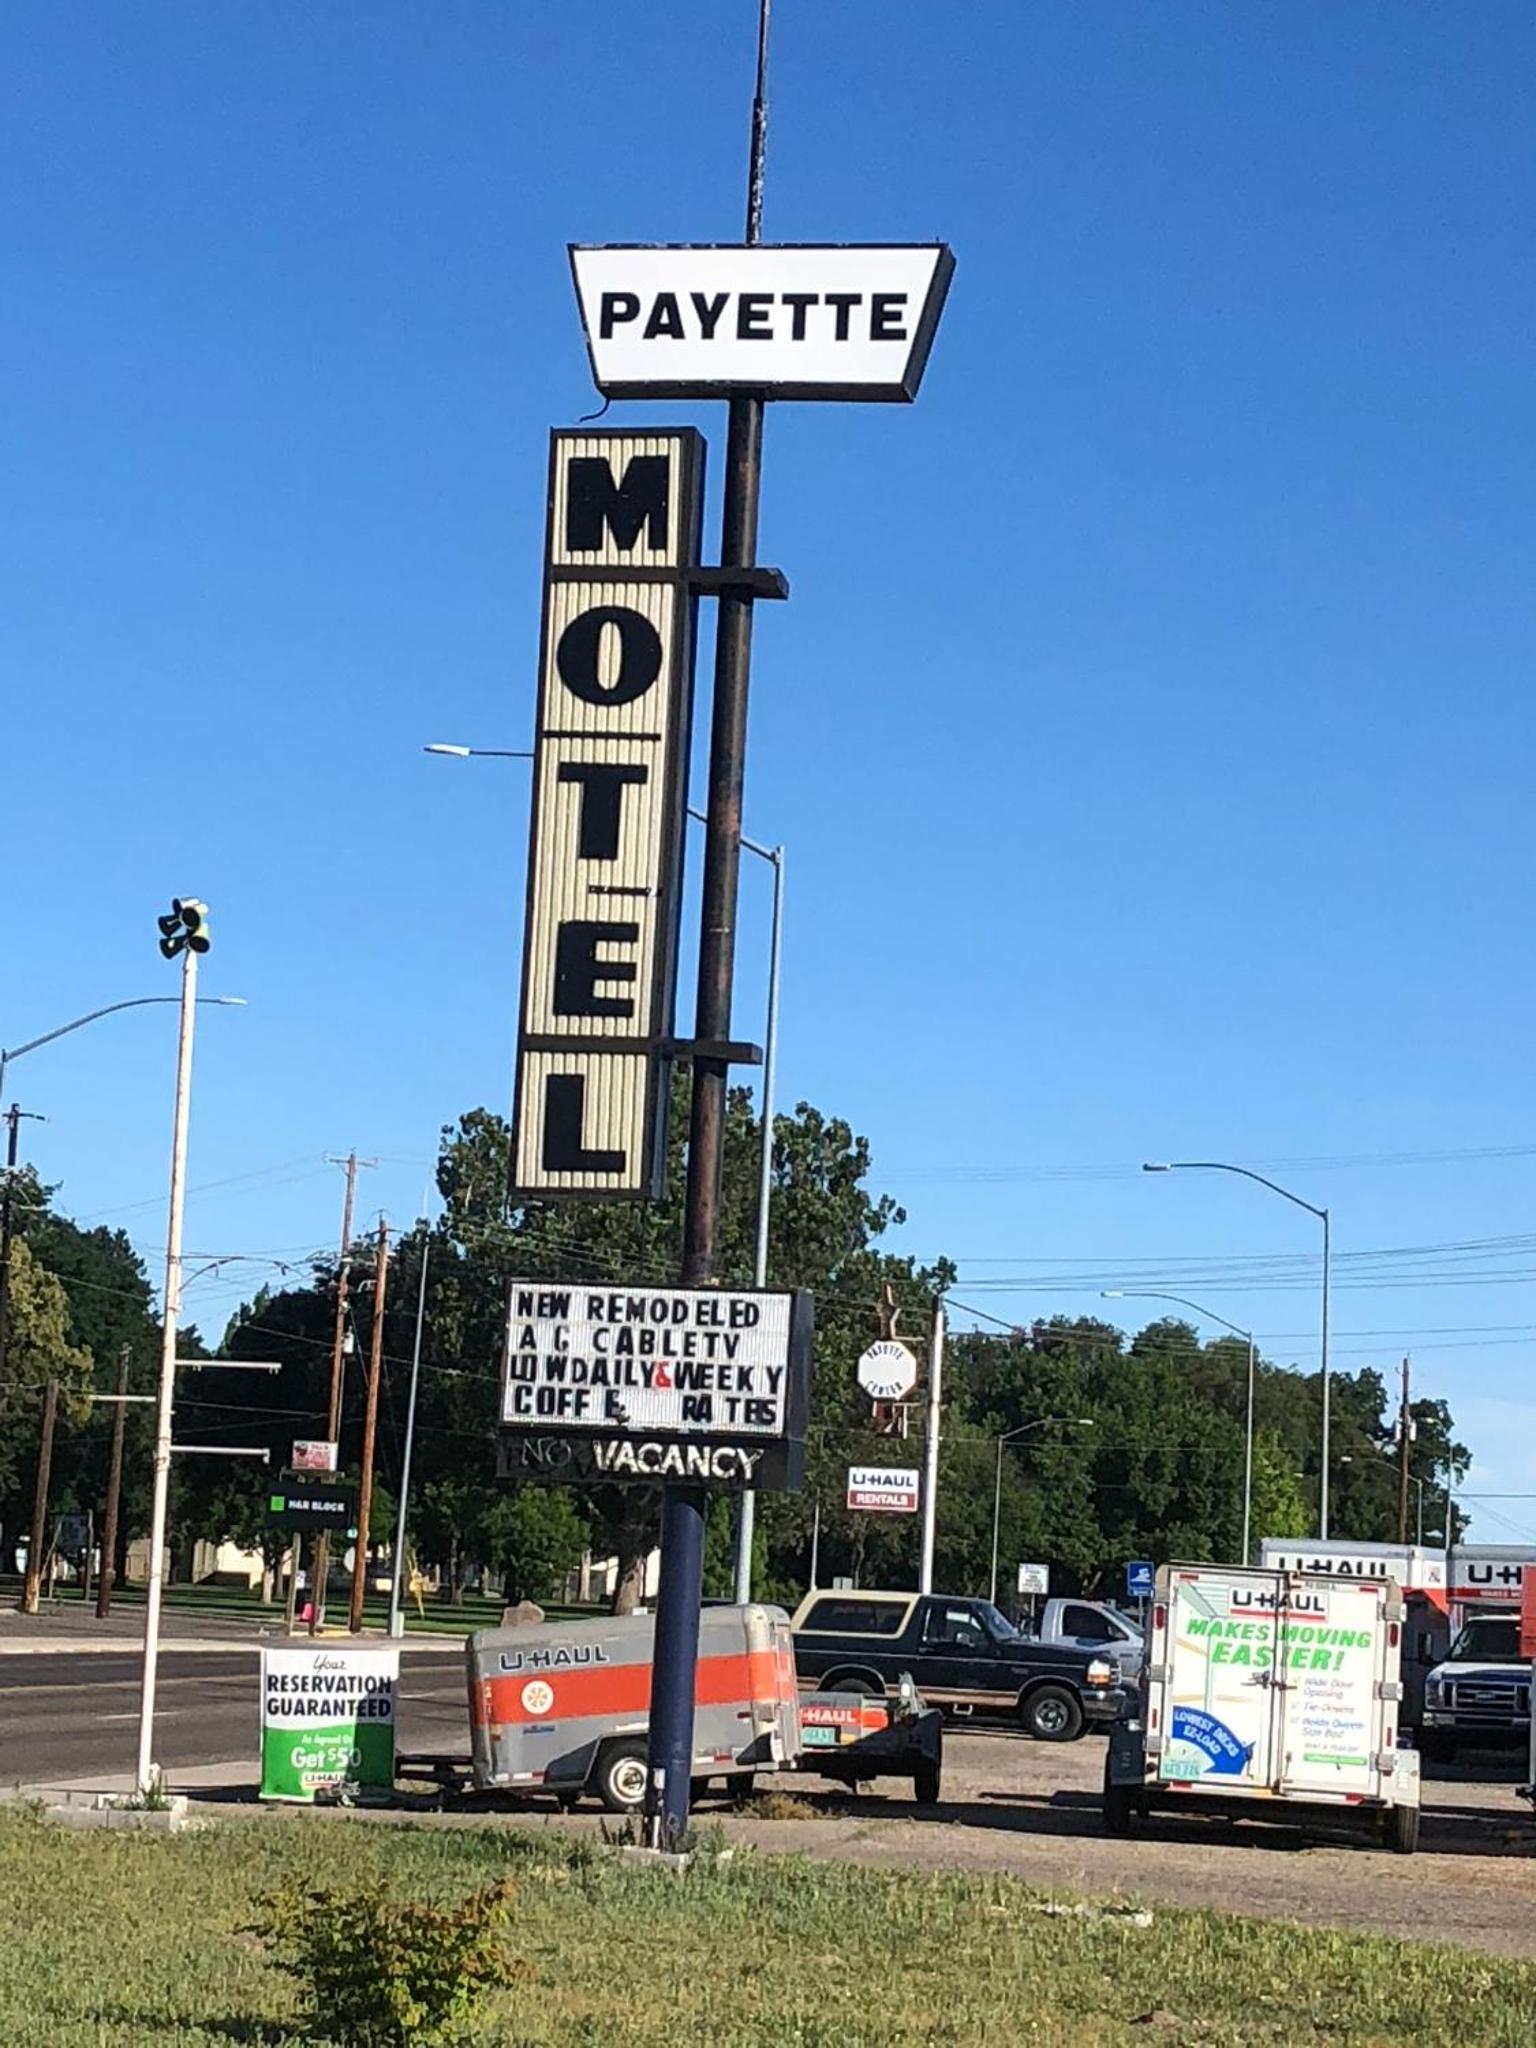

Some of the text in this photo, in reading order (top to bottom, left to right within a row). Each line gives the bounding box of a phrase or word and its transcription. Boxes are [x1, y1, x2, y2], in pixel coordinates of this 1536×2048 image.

[600, 292, 908, 341] PAYETTE
[543, 455, 669, 1173] MOTEL
[518, 1291, 760, 1329] NEW REMODELED
[521, 1436, 765, 1480] NO VACANCY
[852, 1473, 914, 1487] U-HAUL
[311, 1501, 345, 1511] BLOCK
[856, 1493, 909, 1506] RENTALS
[1232, 1590, 1325, 1612] U-HAUL
[1186, 1618, 1372, 1649] MAKES MOVING
[313, 1655, 346, 1674] Your
[499, 1645, 609, 1671] U-HAUL
[267, 1675, 392, 1693] RESERVATION
[267, 1698, 392, 1717] GUARANTEED
[801, 1709, 856, 1722] -HAUL
[291, 1746, 326, 1768] Get
